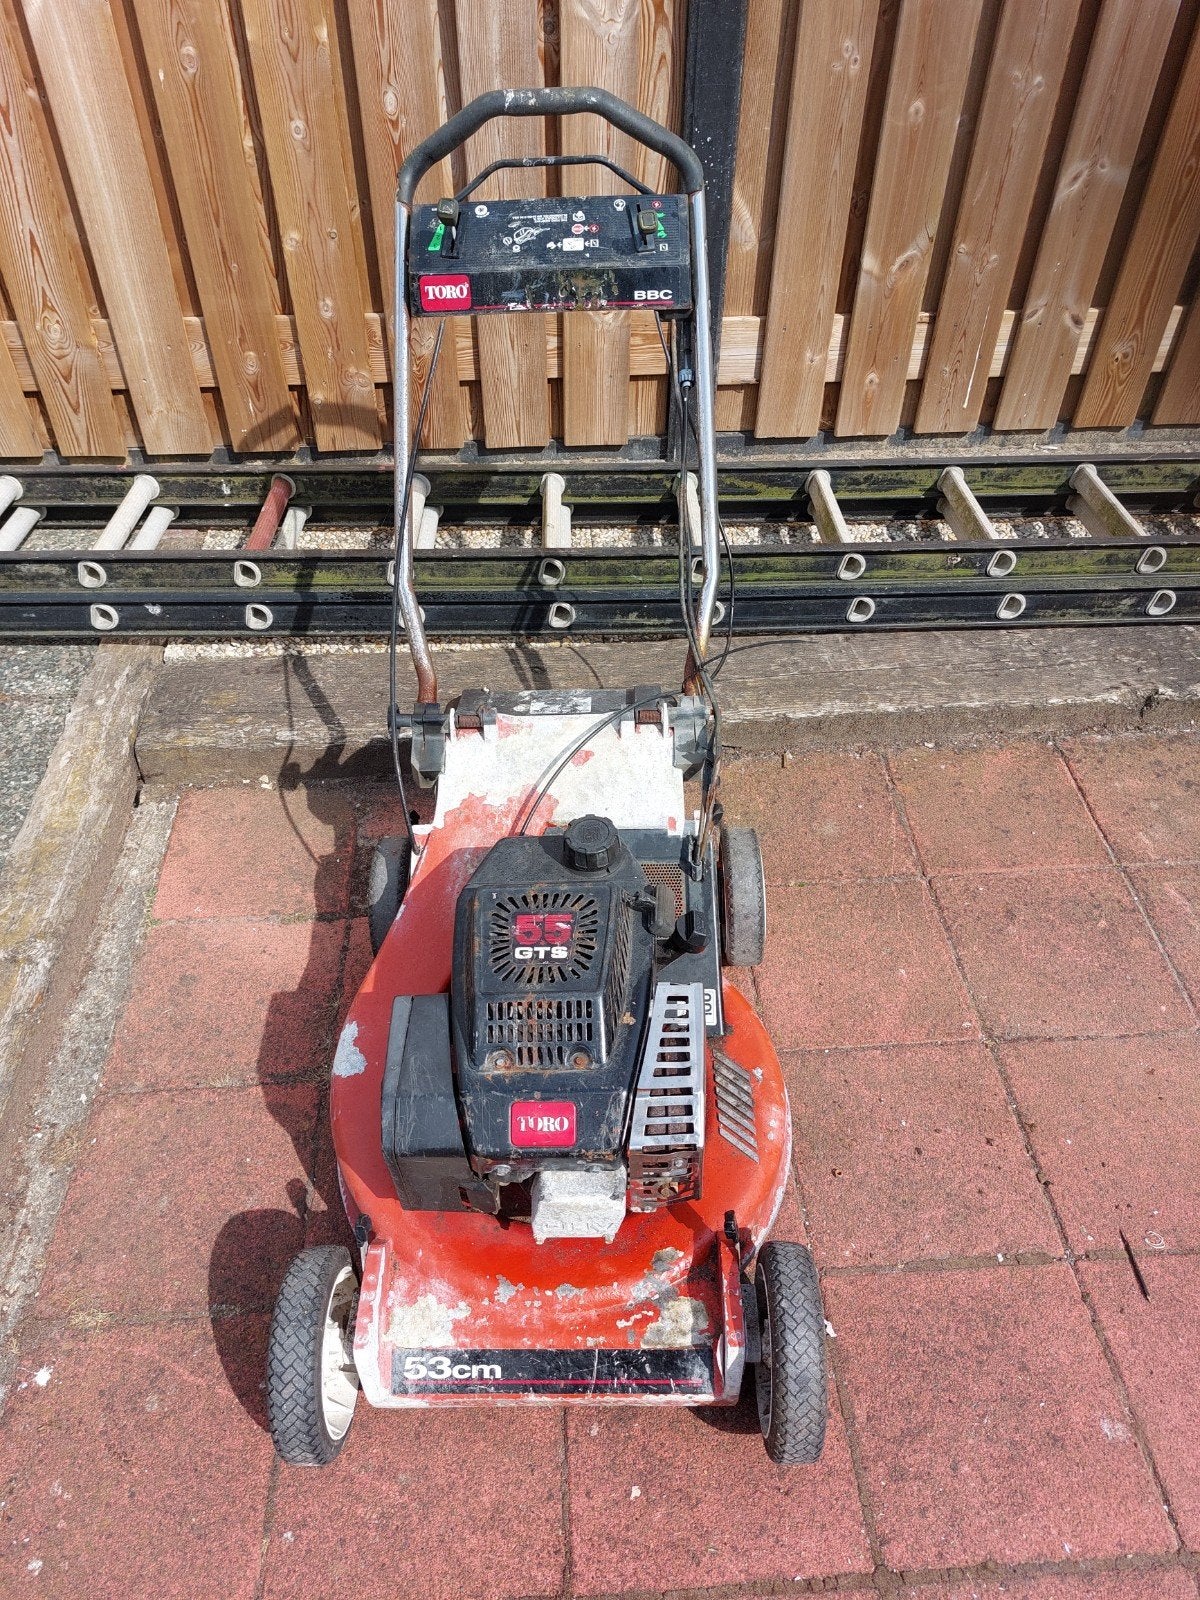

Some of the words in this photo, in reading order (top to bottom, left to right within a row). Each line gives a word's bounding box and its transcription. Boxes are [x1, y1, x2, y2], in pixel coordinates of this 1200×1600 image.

[425, 284, 468, 300] TORO
[633, 289, 673, 301] BBC
[515, 914, 573, 946] 55
[514, 946, 568, 960] GTS
[516, 1116, 569, 1132] TORO
[403, 1356, 502, 1380] 53cm
